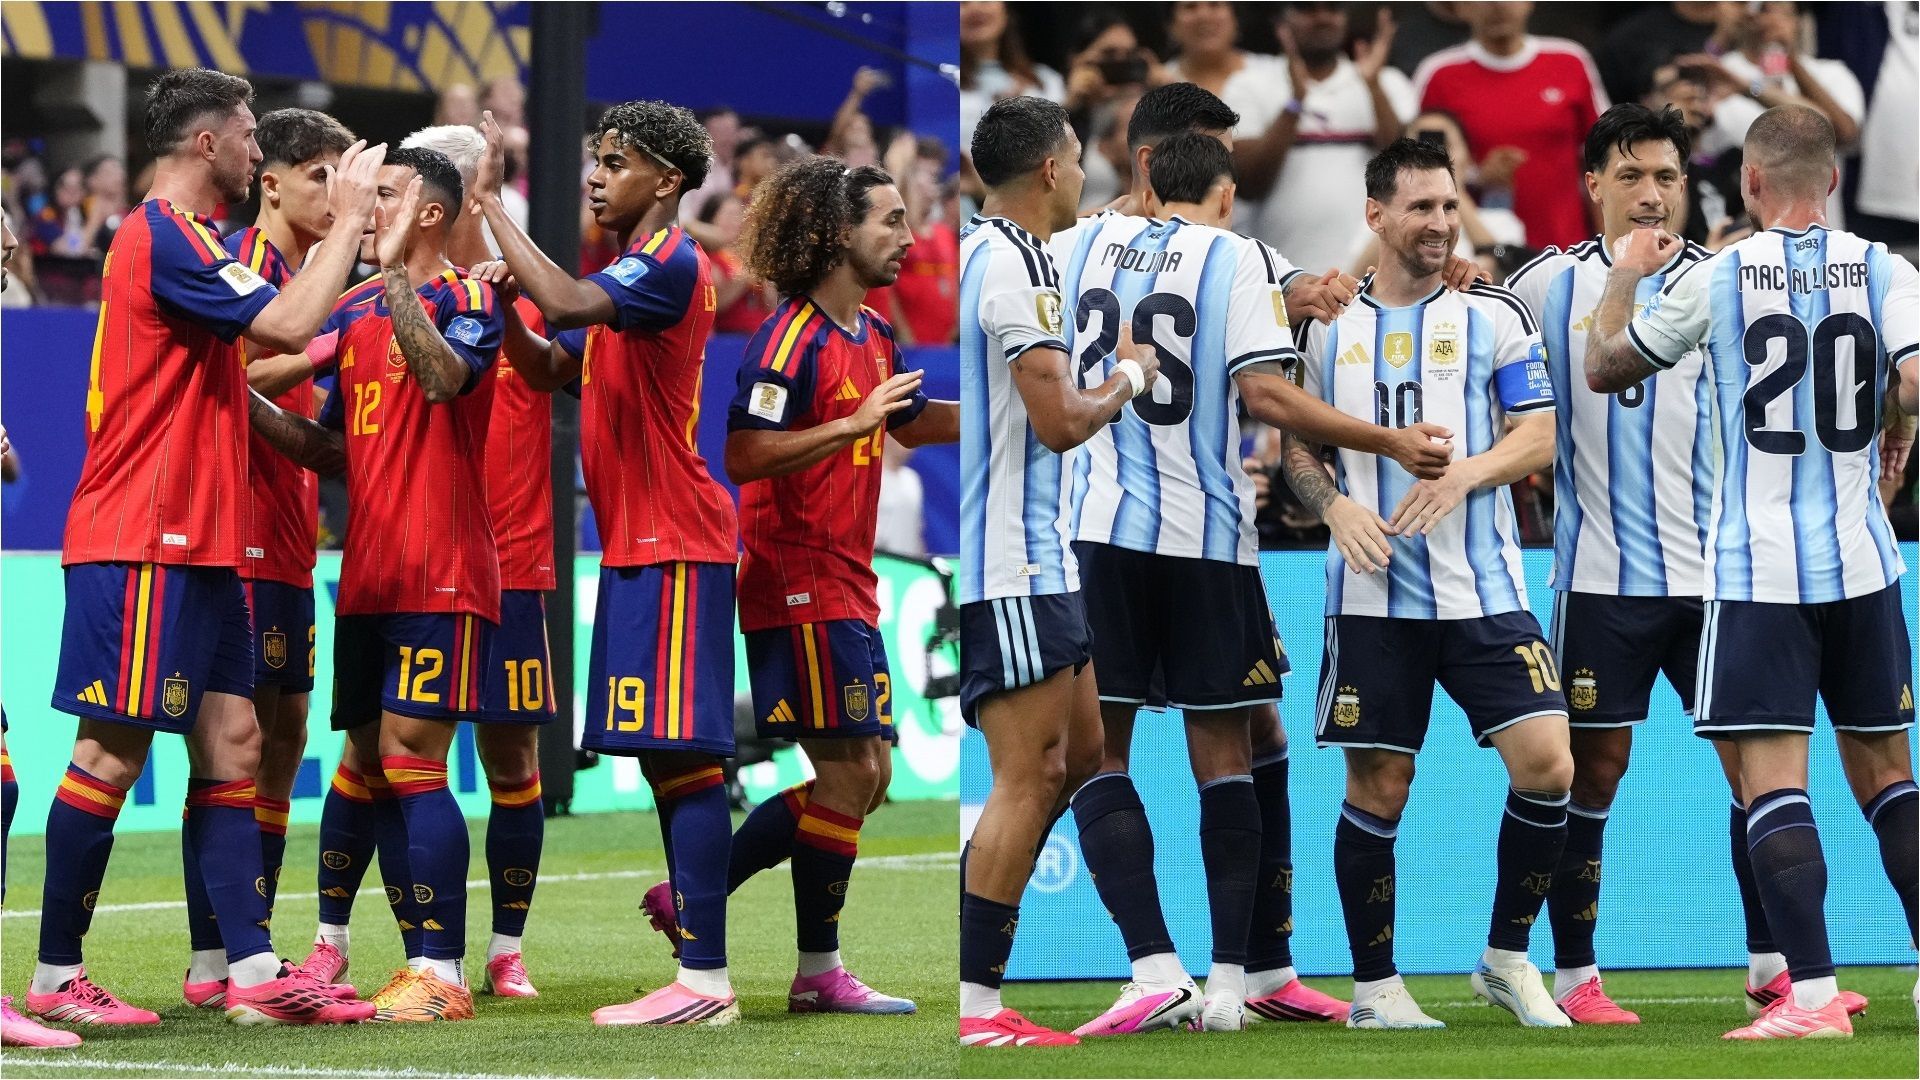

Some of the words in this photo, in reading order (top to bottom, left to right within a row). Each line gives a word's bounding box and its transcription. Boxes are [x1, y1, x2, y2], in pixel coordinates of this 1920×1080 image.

[1101, 242, 1183, 273] MOLINA
[1794, 238, 1819, 253] 1893
[1738, 264, 1786, 292] MAC
[1791, 262, 1869, 295] ALLISTER
[353, 380, 382, 436] 12
[1742, 312, 1877, 456] 20
[397, 645, 444, 703] 12
[504, 658, 545, 712] 10
[1513, 640, 1561, 694] 10
[605, 662, 646, 733] 19
